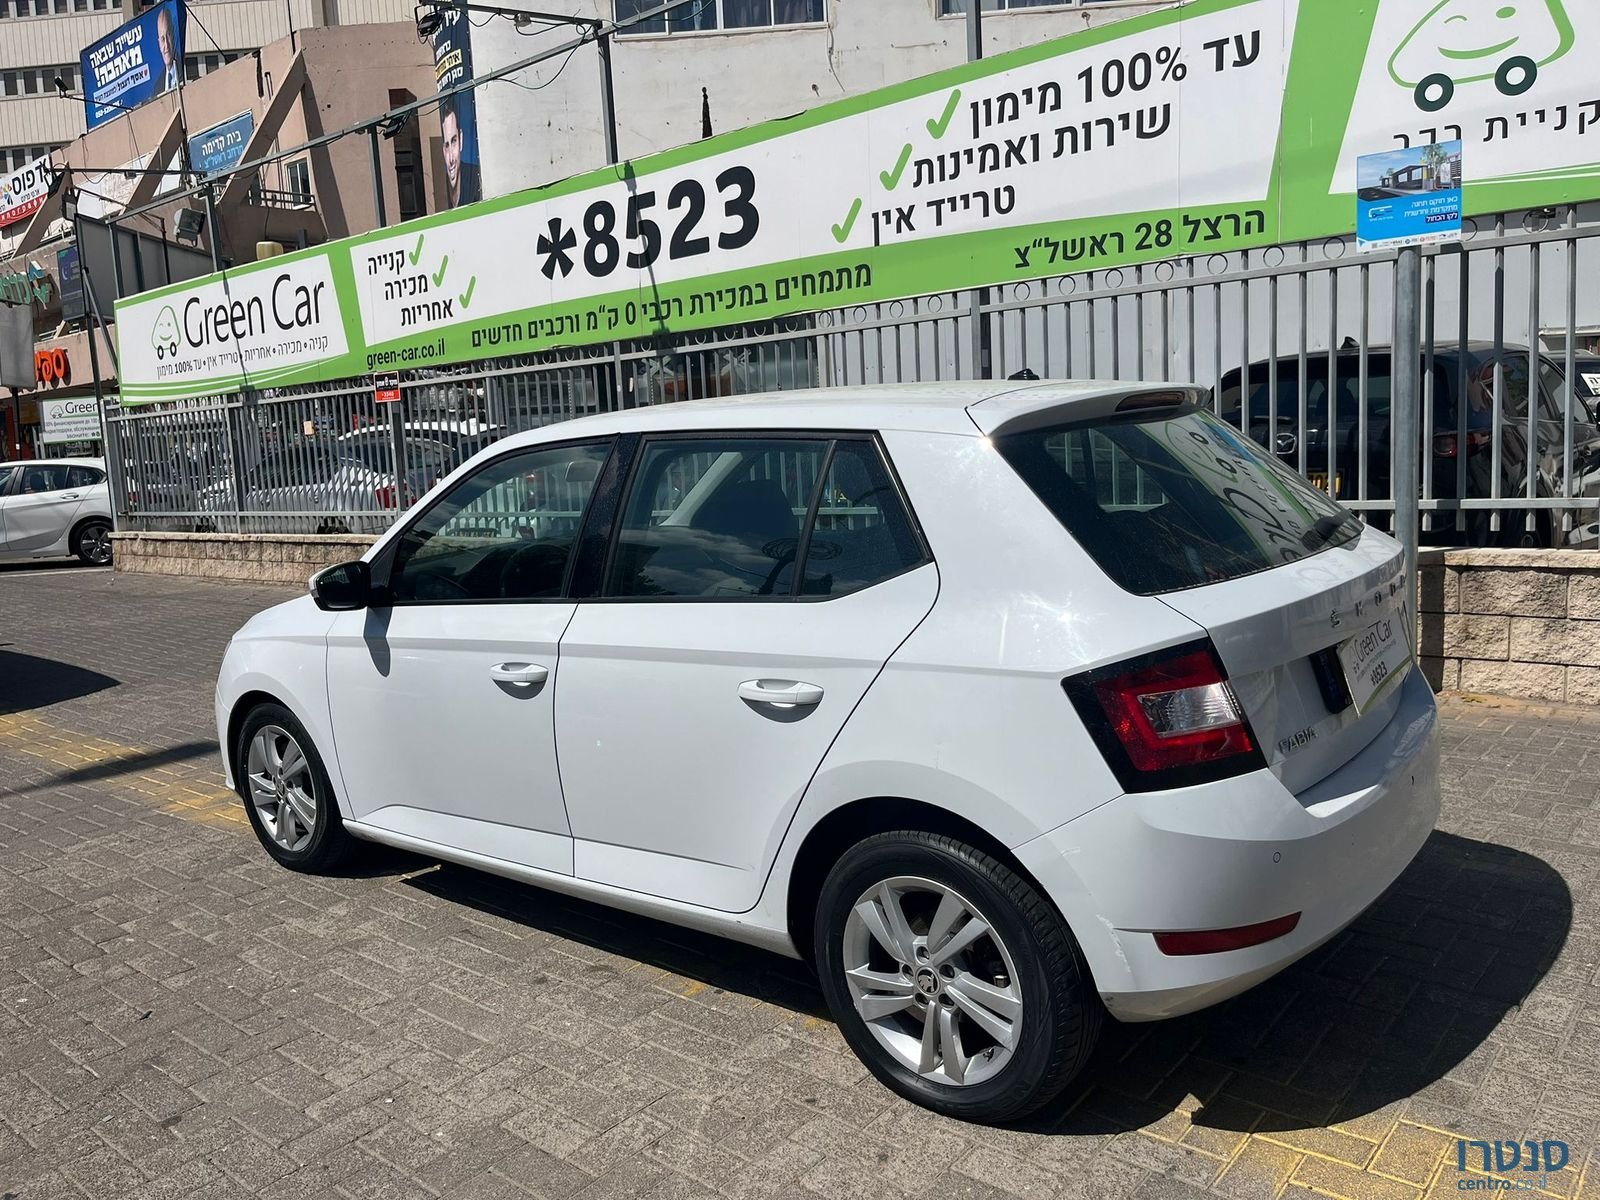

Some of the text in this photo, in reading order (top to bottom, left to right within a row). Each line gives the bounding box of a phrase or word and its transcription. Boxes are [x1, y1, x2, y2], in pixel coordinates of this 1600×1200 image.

[89, 25, 143, 69] עשייה שבאה
[94, 45, 143, 88] מאהבה!
[969, 29, 1262, 140] עד 100% מימון
[202, 130, 242, 156] בית קדימה
[912, 102, 1172, 188] שירות ואמינות
[871, 184, 1016, 246] טרייד אין
[1182, 209, 1265, 244] הרצל
[1135, 219, 1173, 251] 28
[368, 250, 406, 276] קנייה
[384, 274, 429, 300] מכירה
[775, 263, 872, 302] מתמחים
[183, 273, 325, 348] Green Car
[400, 299, 454, 326] אחריות
[625, 302, 637, 326] 0
[641, 298, 683, 323] רכבי
[689, 282, 769, 316] במכירת
[472, 323, 523, 348] חדשים
[528, 314, 580, 339] ורכבים
[157, 335, 328, 380] קניה מכירה אחריות טרייד אין עד 100% מימון
[367, 338, 446, 370] green-car.co.il
[1375, 620, 1393, 642] Car
